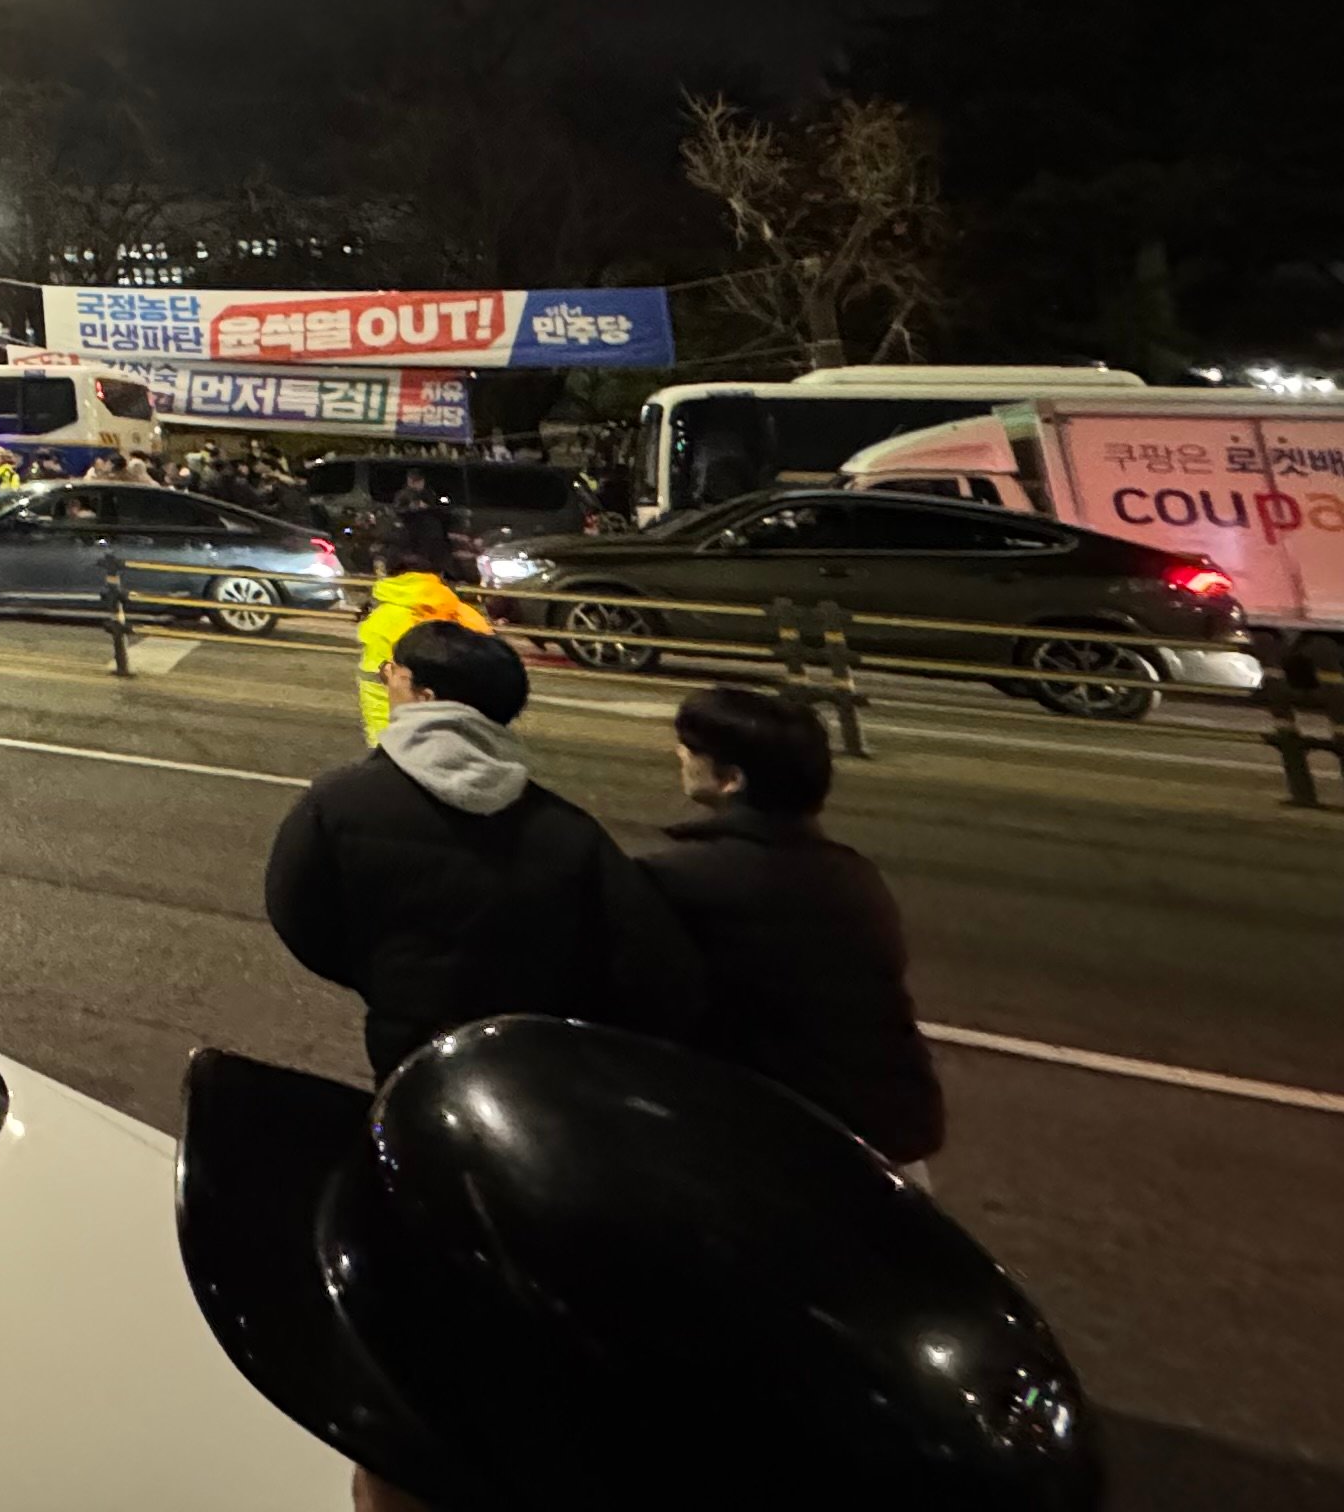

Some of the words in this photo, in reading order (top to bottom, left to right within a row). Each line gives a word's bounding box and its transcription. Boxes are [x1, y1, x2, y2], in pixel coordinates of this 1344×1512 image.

[77, 293, 200, 322] 국정농단
[80, 322, 203, 353] 민생파탄
[218, 309, 351, 356] 윤석열
[357, 297, 494, 346] OUT!
[533, 315, 633, 345] 민주당
[1104, 442, 1213, 475] 쿠팡은
